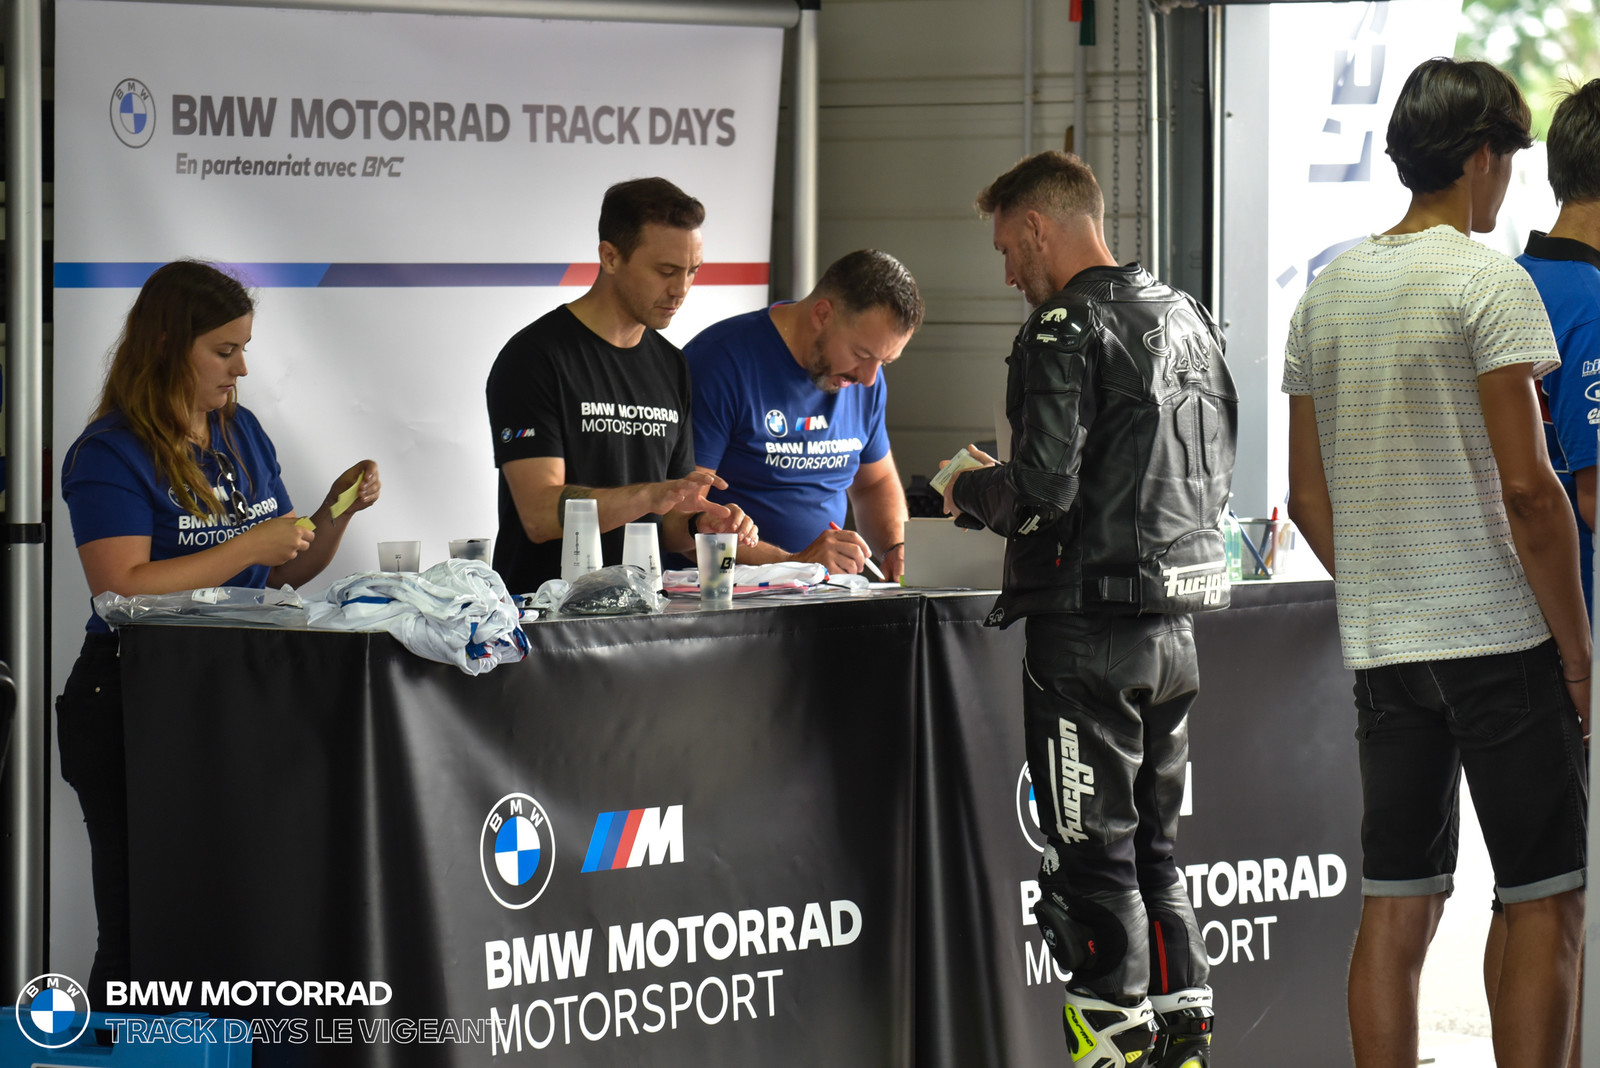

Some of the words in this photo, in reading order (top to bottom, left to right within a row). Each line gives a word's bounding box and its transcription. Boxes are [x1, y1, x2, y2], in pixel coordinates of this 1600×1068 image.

[172, 94, 278, 137] BMW
[291, 98, 511, 142] MOTORRAD
[522, 104, 641, 145] TRACK
[650, 107, 736, 147] DAYS
[175, 153, 198, 174] En
[200, 153, 311, 180] partenariat
[314, 160, 357, 178] avec
[361, 156, 405, 178] BMC
[581, 402, 615, 416] BMW
[618, 403, 679, 424] MOTORRAD
[581, 418, 667, 437] MOTORSPORT
[765, 442, 804, 455] BMW
[765, 454, 850, 469] MOTORSPORT
[1175, 853, 1347, 909] TORRAD
[485, 928, 593, 990] BMW
[608, 899, 863, 973] MOTORRAD
[490, 969, 784, 1056] MOTORSPORT
